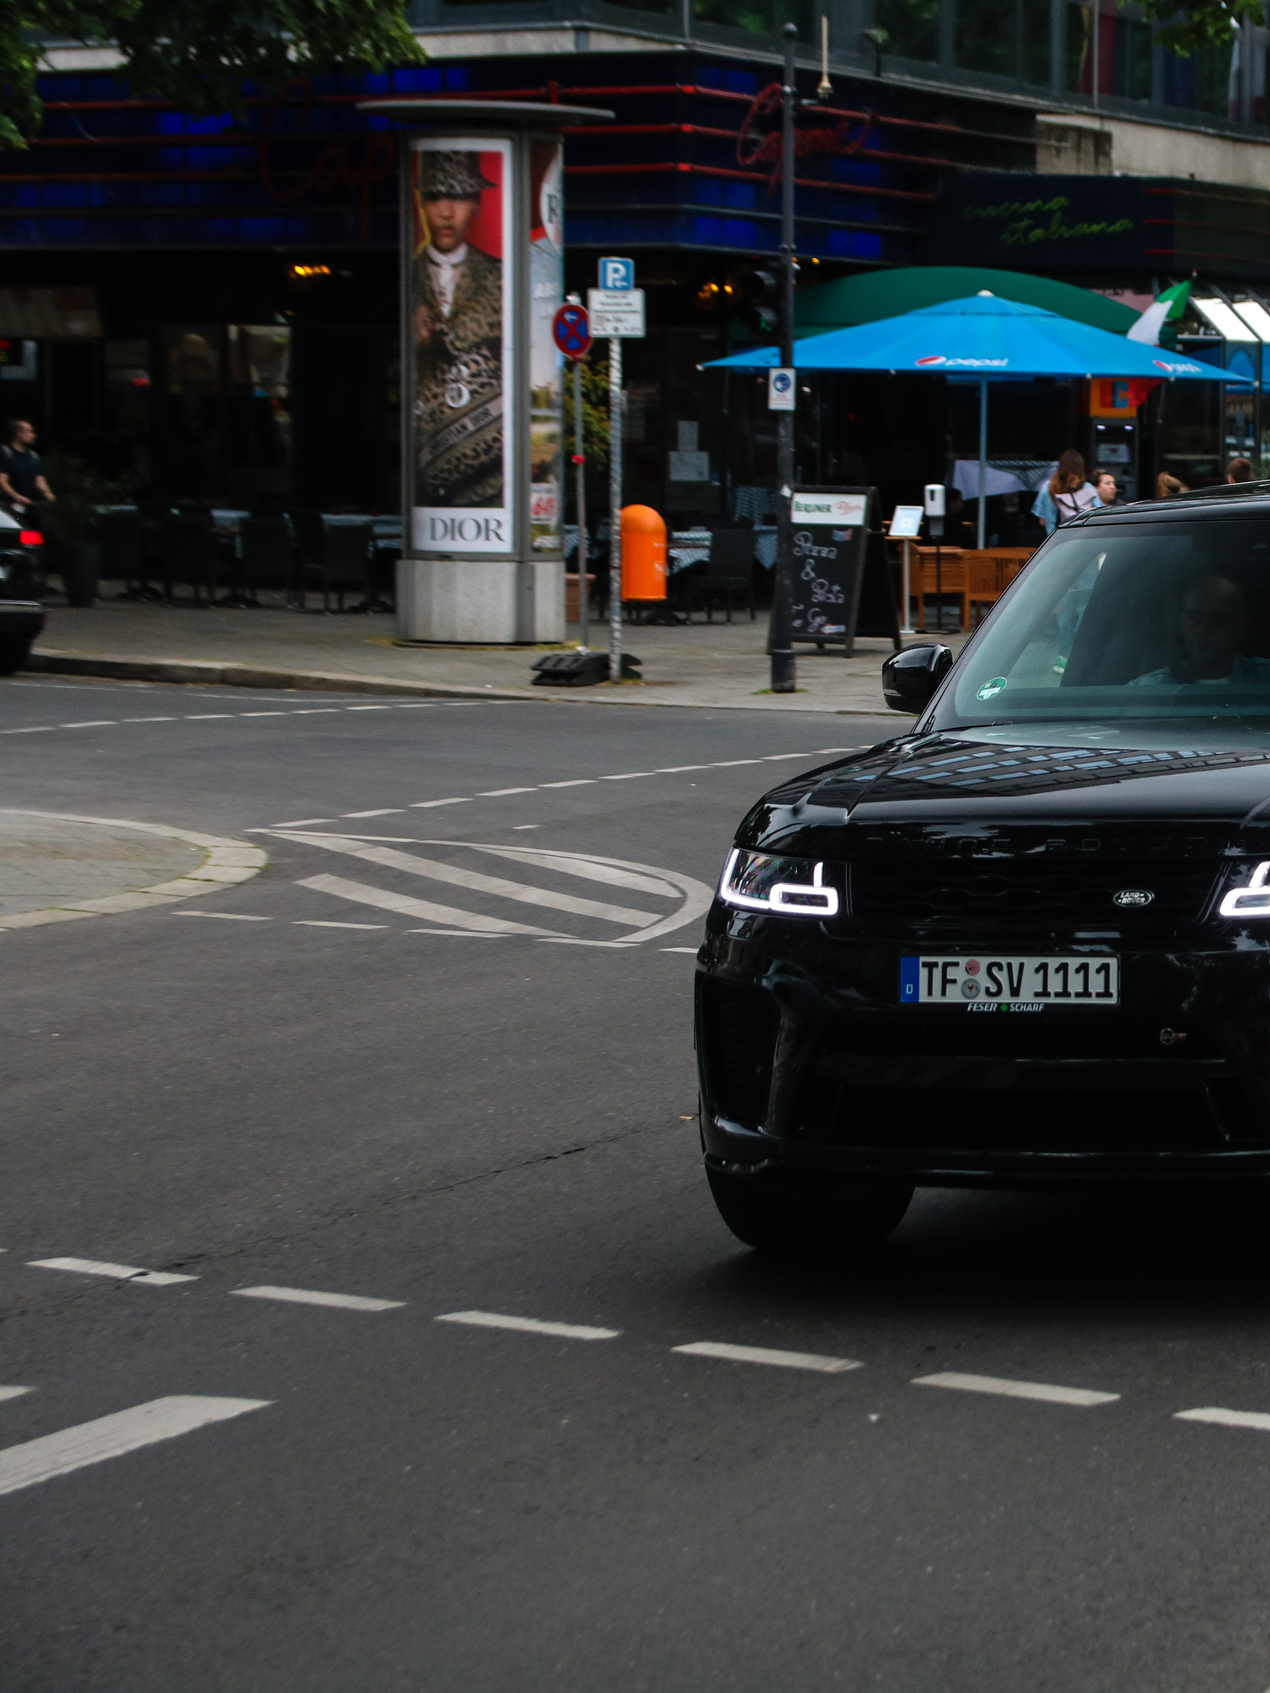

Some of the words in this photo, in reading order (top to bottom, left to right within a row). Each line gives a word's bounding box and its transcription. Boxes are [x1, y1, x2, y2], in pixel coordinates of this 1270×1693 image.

[945, 357, 1009, 368] pepsi
[793, 500, 832, 513] BERLINER
[429, 517, 505, 542] DIOR
[921, 961, 960, 996] TF
[985, 961, 1025, 997] SV
[1034, 962, 1114, 998] 1111
[906, 984, 913, 995] D
[967, 1003, 998, 1012] FESER
[1009, 1003, 1045, 1012] SCHARF
